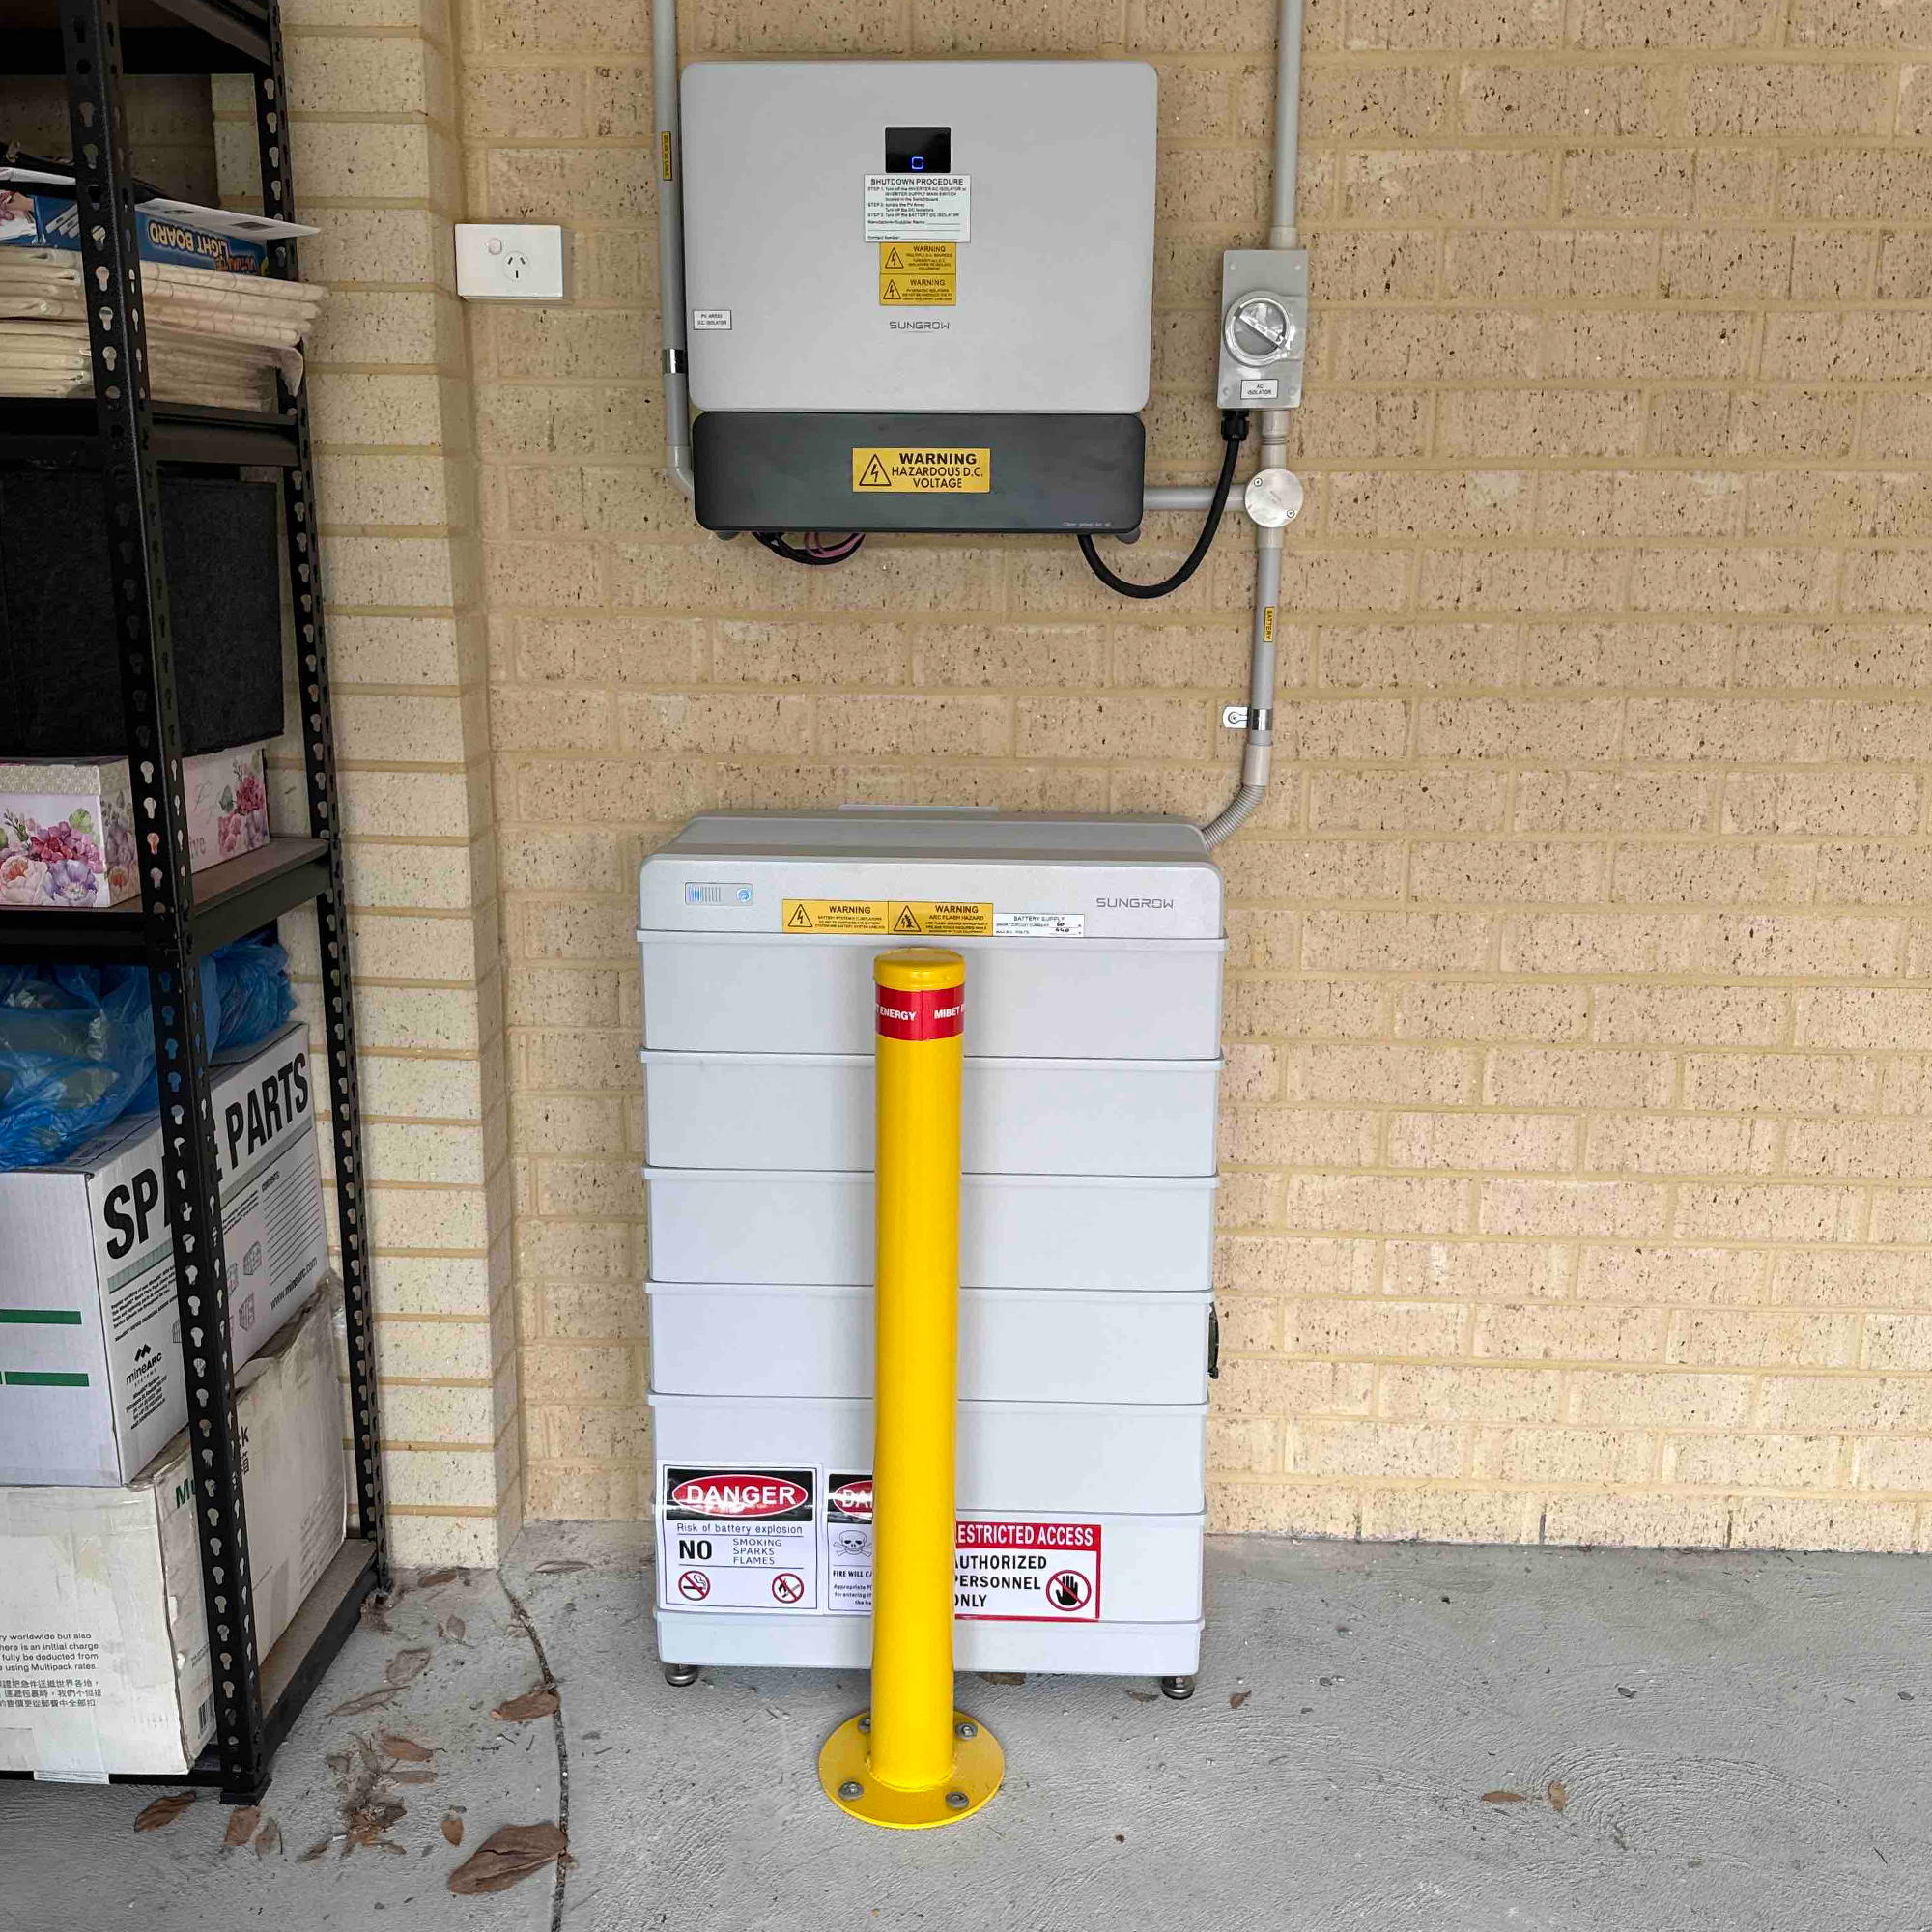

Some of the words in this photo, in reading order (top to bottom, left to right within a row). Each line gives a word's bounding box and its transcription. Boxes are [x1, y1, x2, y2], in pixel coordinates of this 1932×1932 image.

[150, 222, 194, 251] BOARD
[889, 321, 951, 330] SUNGROW
[899, 453, 977, 465] WARNING
[892, 467, 960, 477] HAZARDOUS
[963, 468, 983, 477] D.C.
[913, 477, 962, 489] VOLTAGE
[1095, 898, 1174, 908] SUNGROW
[935, 905, 979, 914] WARNING
[880, 1006, 916, 1021] ENERGY
[934, 1005, 960, 1020] MIBET
[225, 1053, 308, 1170] PARTS
[126, 1352, 162, 1386] mineARC
[686, 1485, 796, 1505] DANGER
[677, 1522, 697, 1532] Risk
[702, 1523, 711, 1532] of
[715, 1524, 752, 1536] battery
[755, 1524, 803, 1536] explosion
[956, 1524, 1034, 1545] ESTRICTED
[1037, 1526, 1094, 1546] ACCESS
[732, 1538, 782, 1547] SMOKING
[679, 1540, 713, 1560] NO
[733, 1556, 775, 1565] FLAMES
[834, 1584, 866, 1593] Appropriate
[69, 1642, 99, 1652] charge
[2, 1654, 20, 1662] fully
[6, 1664, 29, 1673] using
[31, 1663, 72, 1672] Multipack
